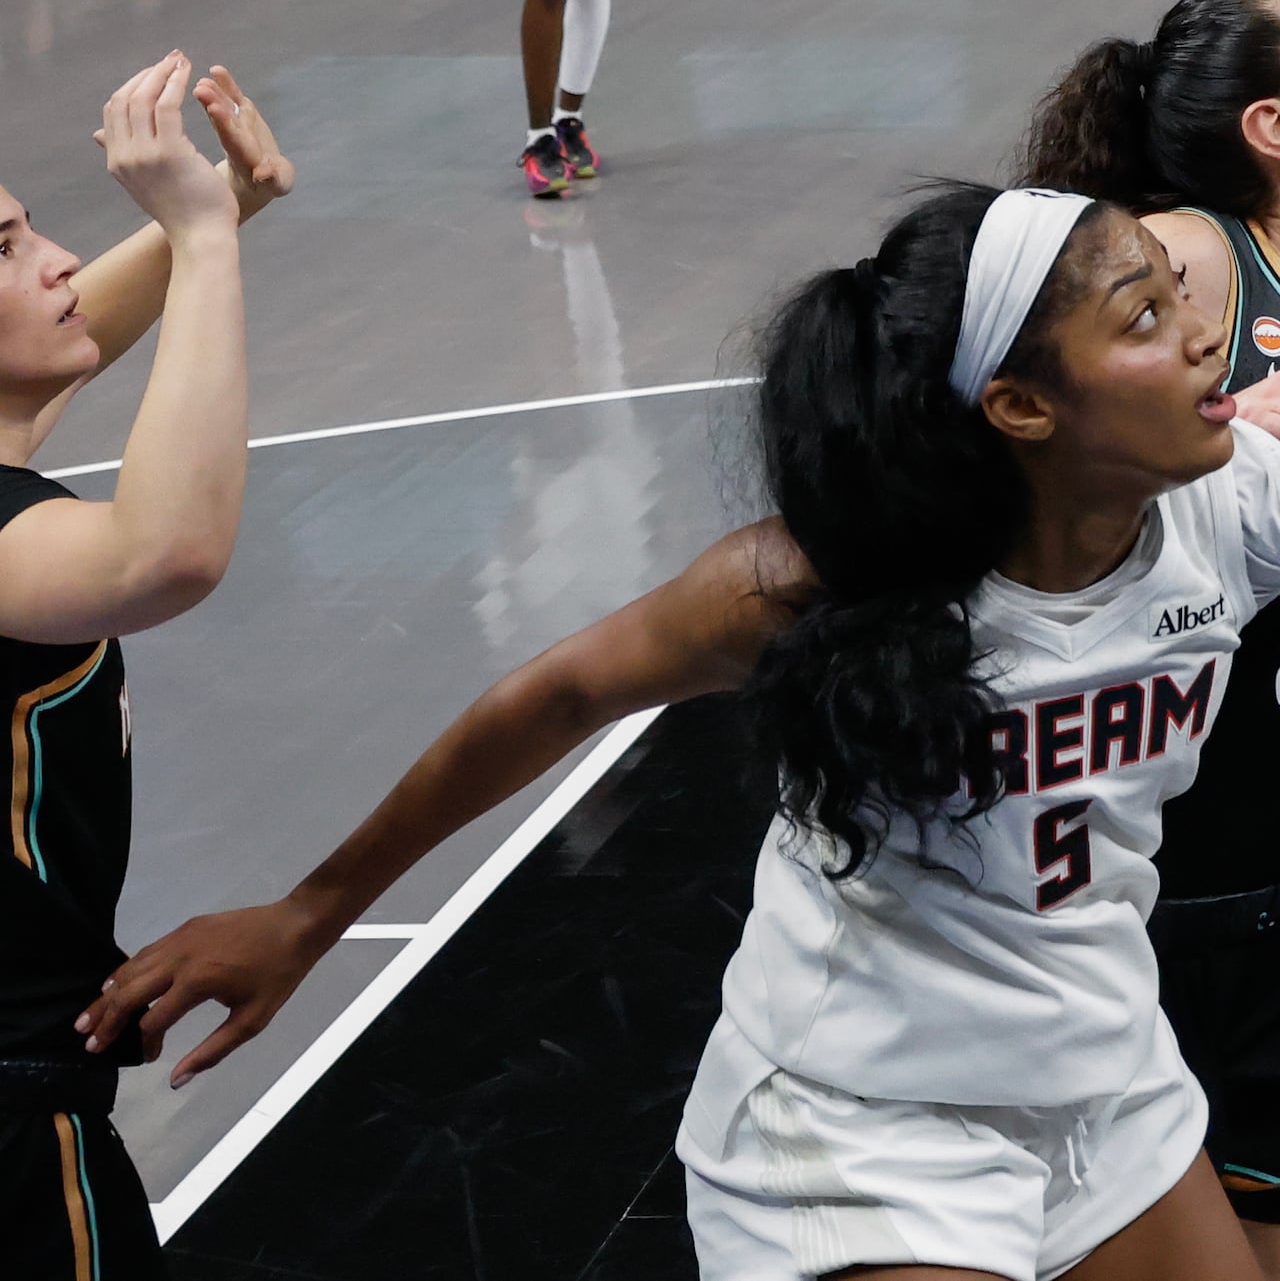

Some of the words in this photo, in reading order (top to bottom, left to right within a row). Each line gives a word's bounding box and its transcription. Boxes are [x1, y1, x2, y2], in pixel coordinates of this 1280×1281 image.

[1152, 594, 1226, 638] Albert
[936, 657, 1216, 799] REAM
[1033, 798, 1093, 912] 5
